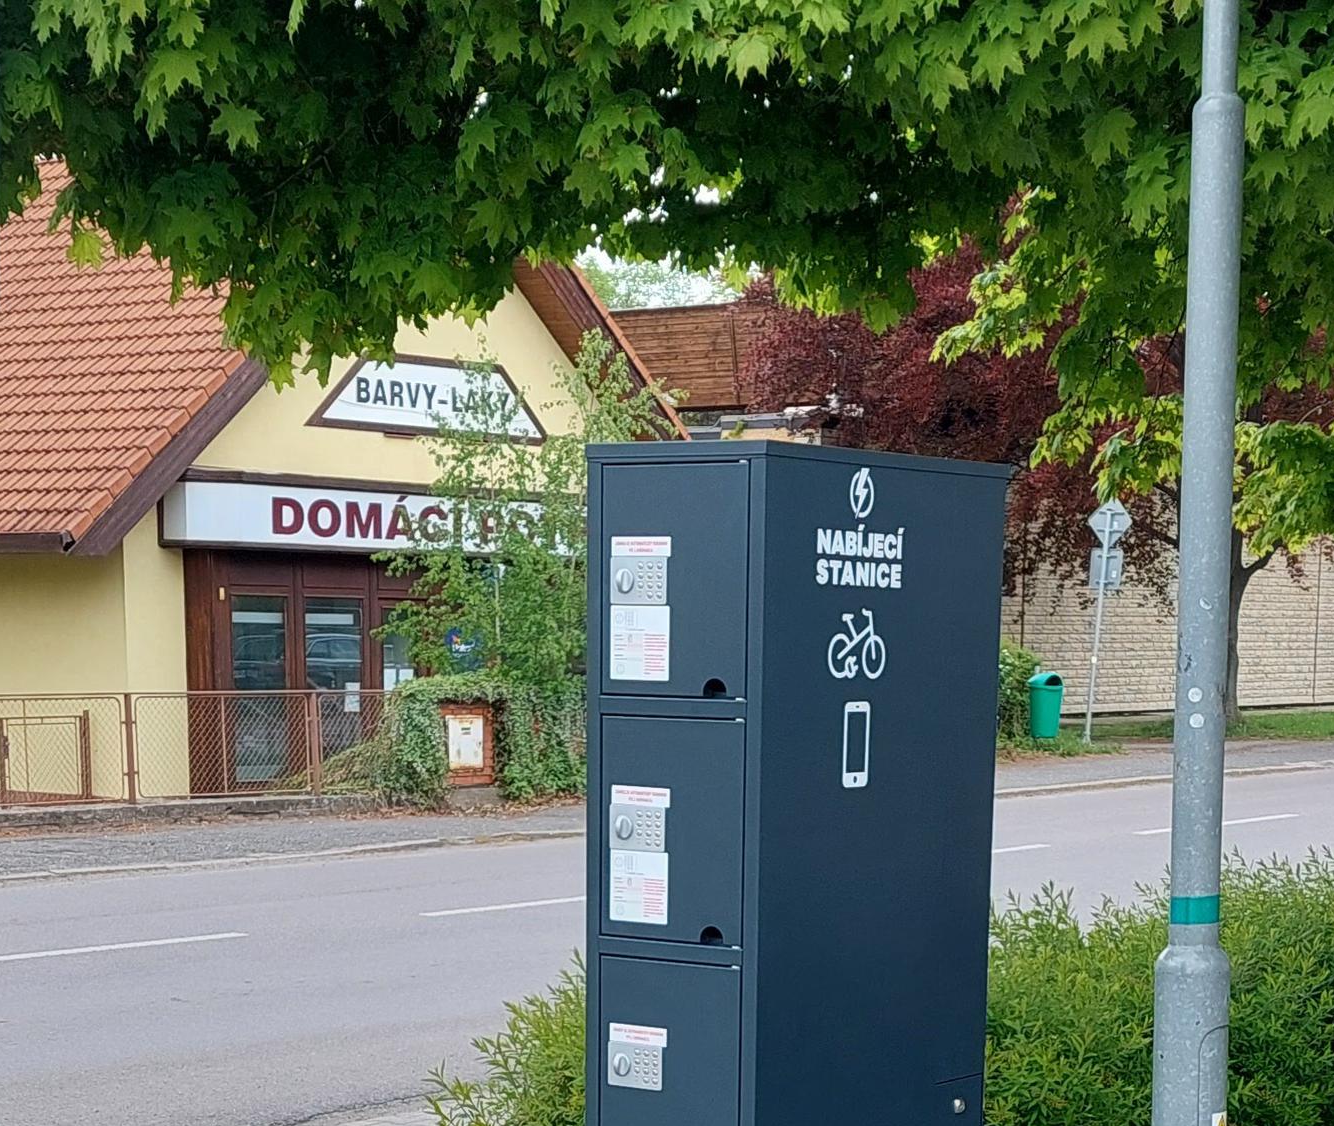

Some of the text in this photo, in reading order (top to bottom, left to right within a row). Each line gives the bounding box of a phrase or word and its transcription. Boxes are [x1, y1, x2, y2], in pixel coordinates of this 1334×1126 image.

[356, 376, 510, 415] BARVY-LAKY
[816, 523, 905, 559] NABÍJECÍ
[815, 558, 902, 589] STANICE
